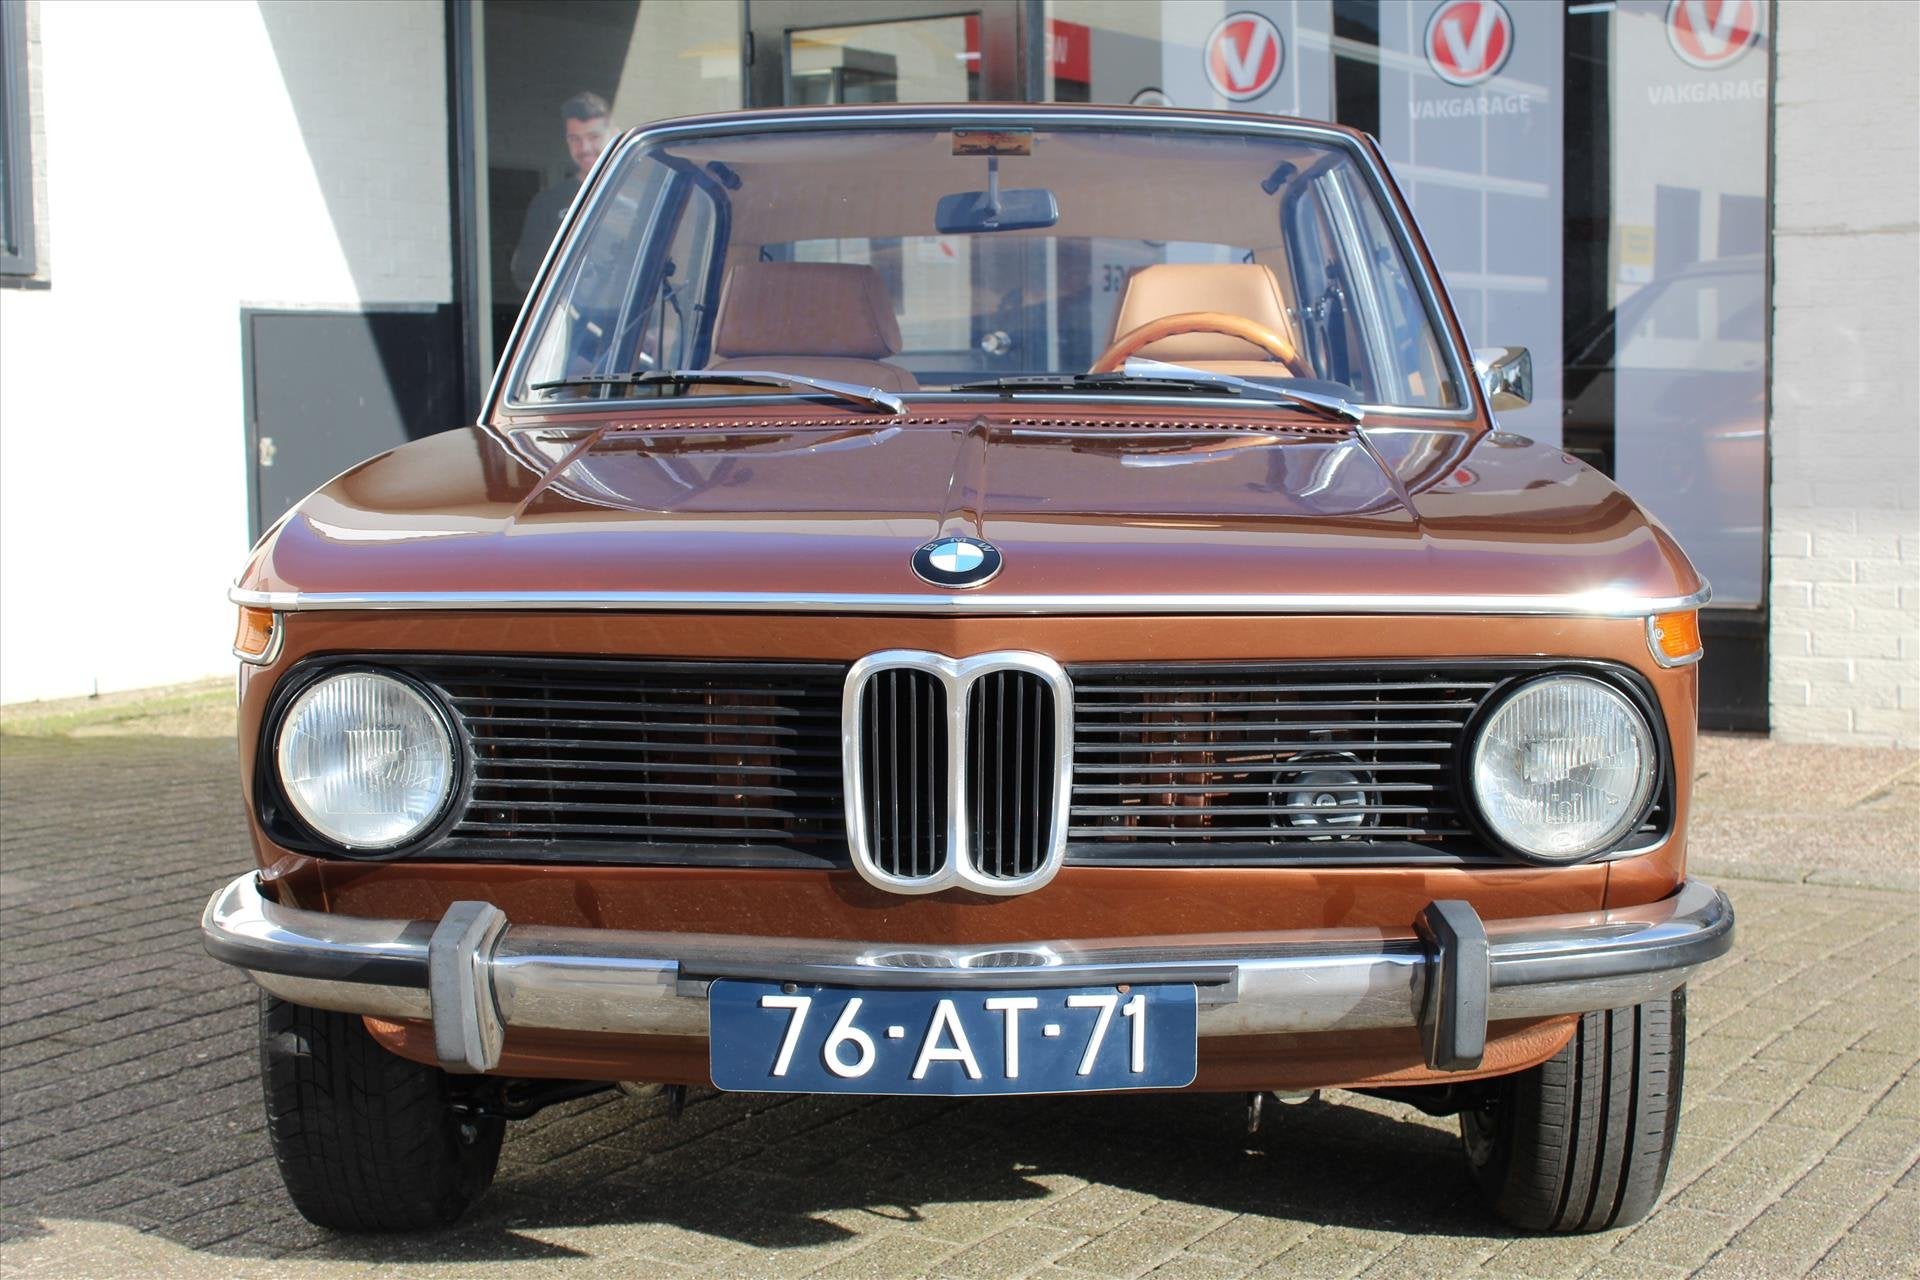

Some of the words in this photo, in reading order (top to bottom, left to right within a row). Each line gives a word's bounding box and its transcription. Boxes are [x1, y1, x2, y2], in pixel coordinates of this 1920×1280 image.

[1220, 20, 1269, 87] V
[1442, 2, 1497, 71] V
[1408, 94, 1531, 119] VAKGARAGE
